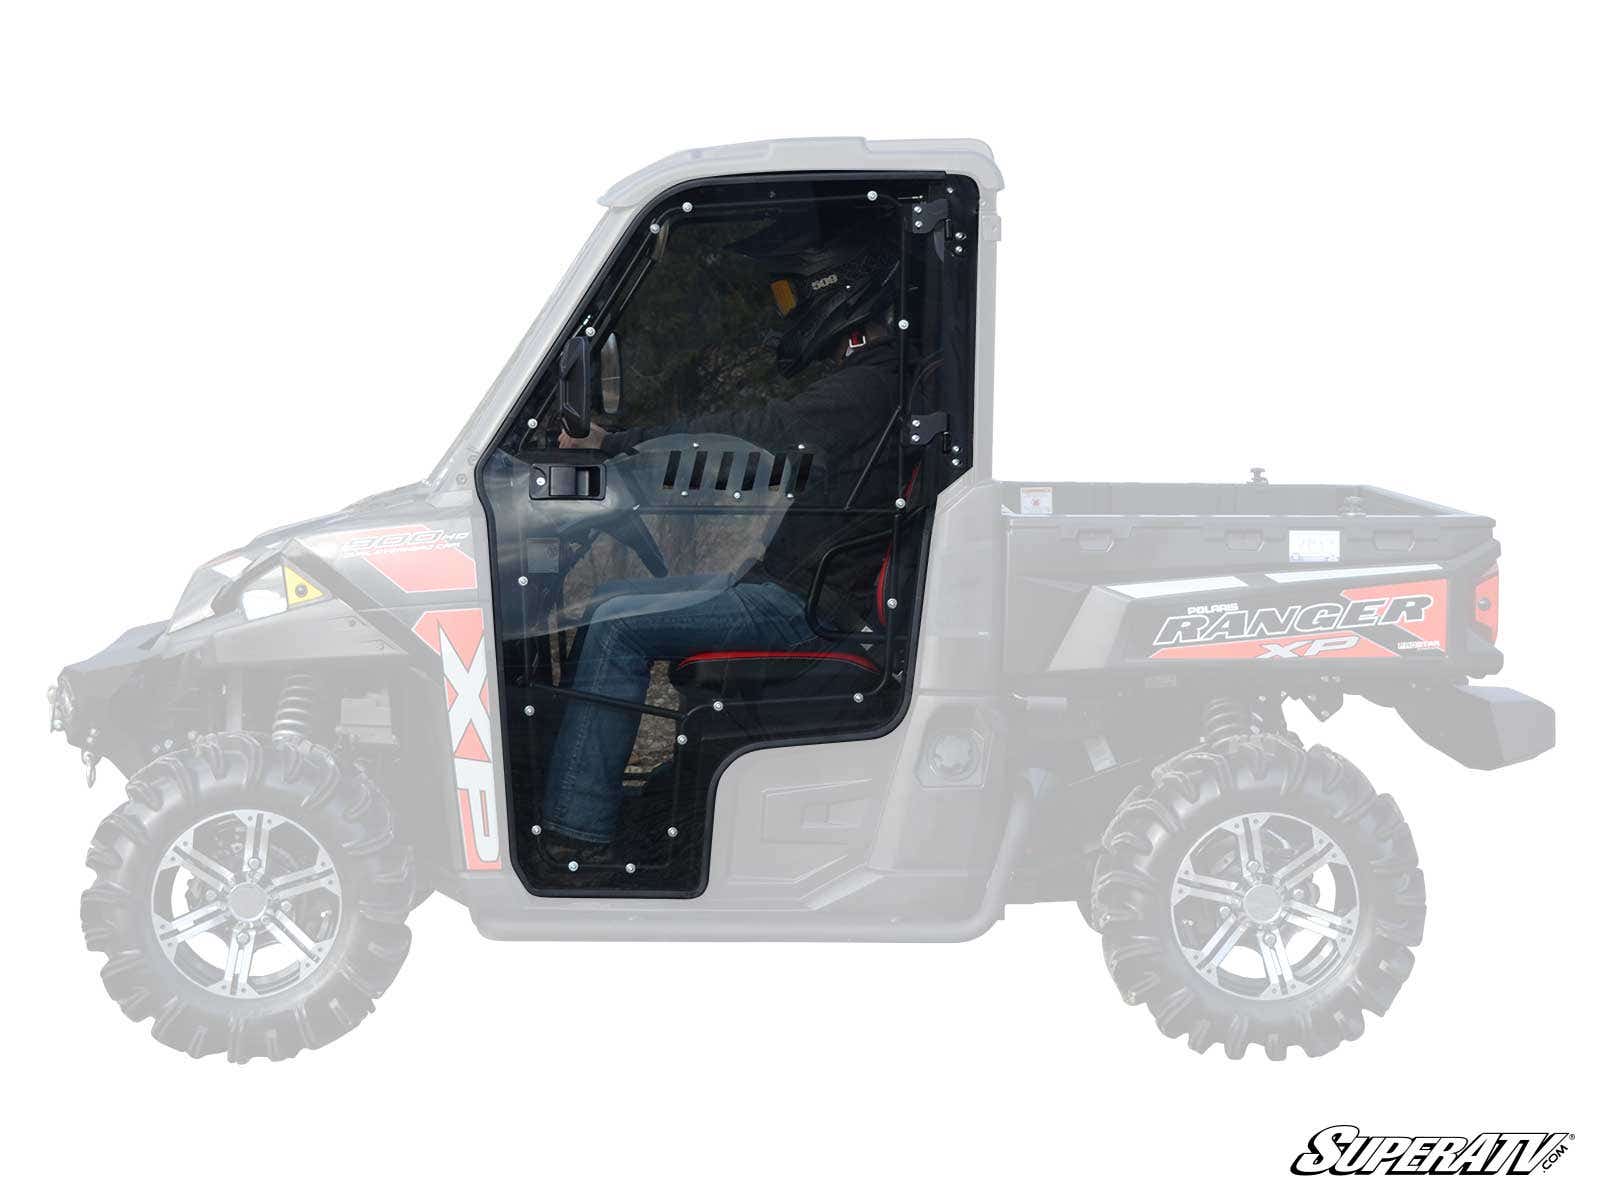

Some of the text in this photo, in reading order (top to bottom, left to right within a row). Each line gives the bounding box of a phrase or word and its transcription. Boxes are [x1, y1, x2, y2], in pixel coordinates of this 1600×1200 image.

[811, 274, 838, 290] 509
[1152, 594, 1434, 646] RANGER
[1187, 602, 1239, 615] POLARIS
[1253, 634, 1360, 660] XP
[438, 622, 500, 862] XP
